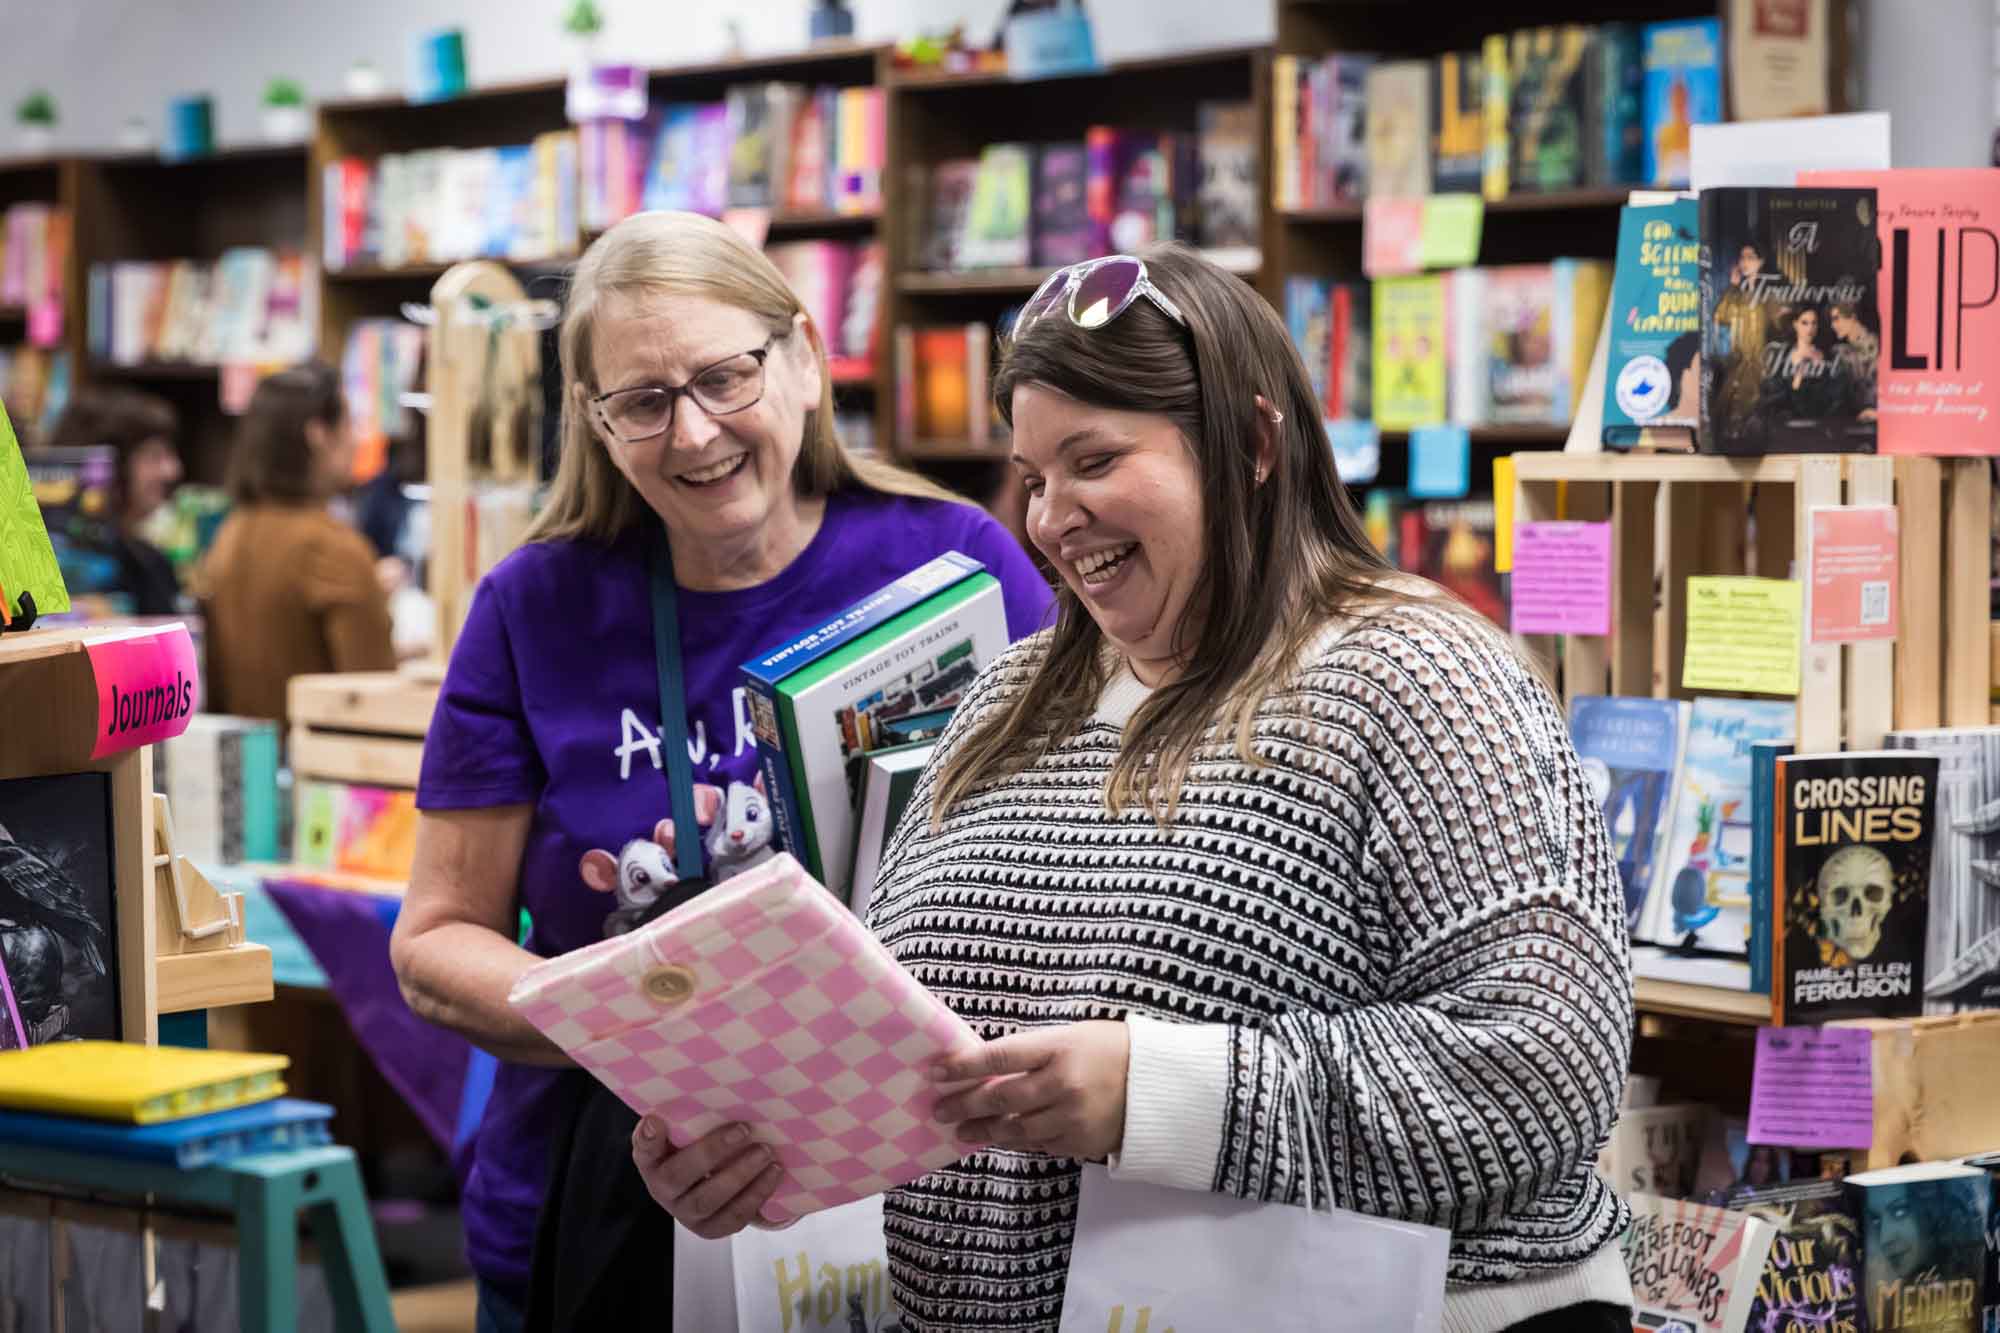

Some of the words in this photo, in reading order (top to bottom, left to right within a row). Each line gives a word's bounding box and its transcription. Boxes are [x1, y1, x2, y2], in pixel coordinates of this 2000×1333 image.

[1640, 241, 1700, 266] SCIEN
[1788, 221, 1819, 254] A
[1877, 228, 1999, 371] LIP
[762, 633, 819, 667] VINTAGE
[841, 659, 892, 691] VINTAGE
[895, 645, 916, 663] TOY
[919, 621, 960, 648] TRAINS
[108, 671, 191, 736] Journals
[1794, 775, 1925, 810] CROSSING
[1795, 806, 1923, 846] LINES
[1857, 961, 1911, 979] ELLEN
[1794, 977, 1911, 1004] FERGUSON
[1627, 1214, 1658, 1244] THE
[1770, 1236, 1816, 1269] Our
[773, 1250, 896, 1333] Ham
[1629, 1248, 1724, 1322] FOLLOWERS
[1648, 1287, 1667, 1303] OF
[1758, 1260, 1857, 1311] Vicious
